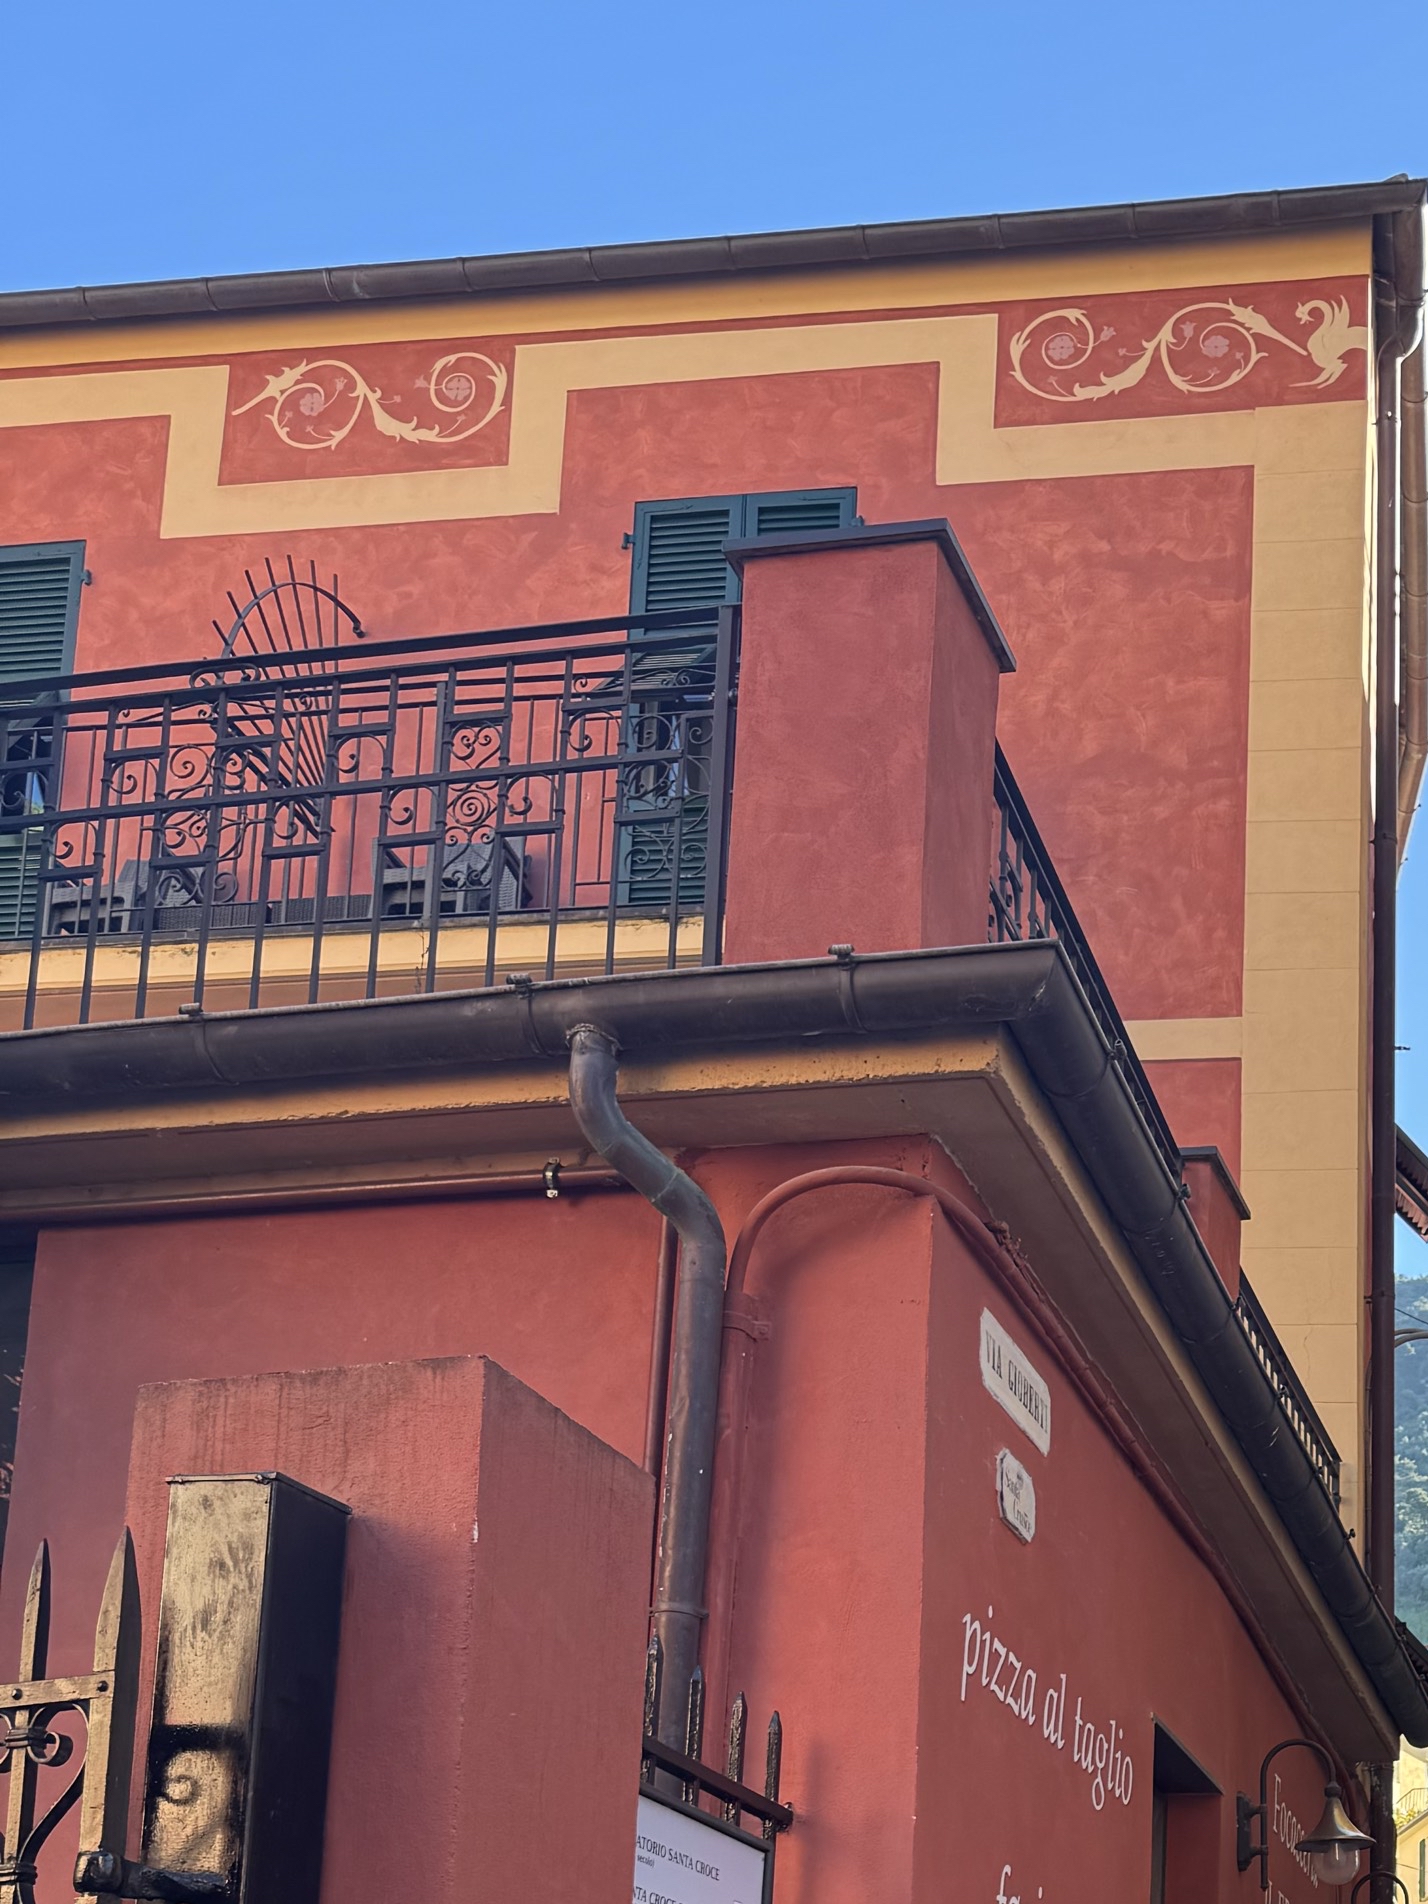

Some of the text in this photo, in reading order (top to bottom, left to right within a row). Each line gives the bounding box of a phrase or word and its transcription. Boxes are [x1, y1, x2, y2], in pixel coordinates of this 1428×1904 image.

[984, 1328, 1048, 1435] VIA GIOBERTI
[962, 1605, 1134, 1811] pizza al taglio
[668, 1848, 694, 1872] SANTA
[695, 1860, 720, 1881] CROCE
